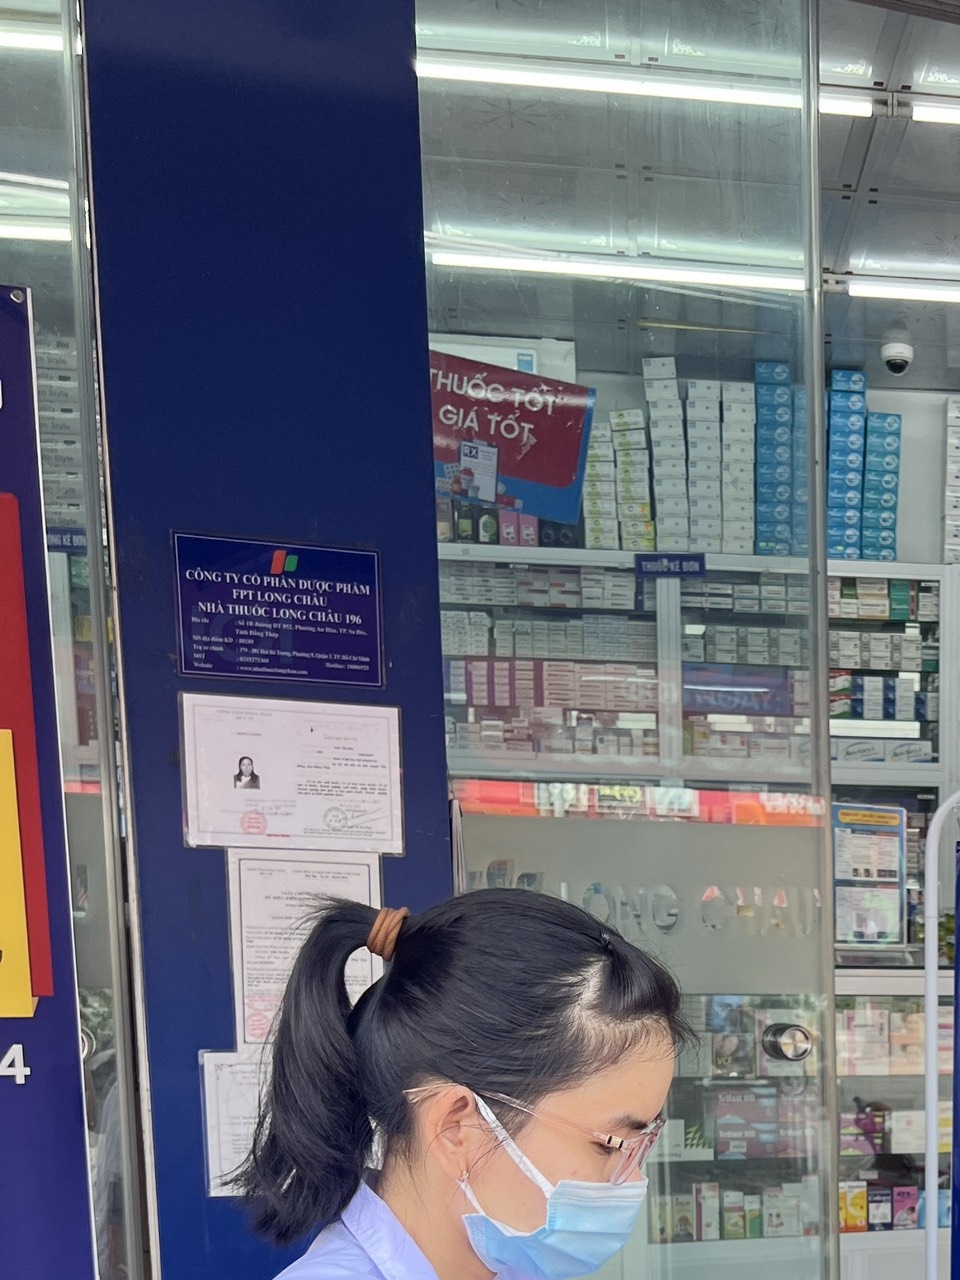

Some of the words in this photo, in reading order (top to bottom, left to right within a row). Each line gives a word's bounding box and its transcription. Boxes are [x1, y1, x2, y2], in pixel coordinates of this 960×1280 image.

[438, 404, 479, 432] GIÁ
[186, 567, 221, 583] CÔNG
[224, 573, 241, 584] TY
[299, 579, 333, 594] DƯỢC
[232, 589, 254, 601] FPT
[257, 591, 291, 604] LONG
[294, 593, 328, 607] CHÂU
[198, 600, 224, 614] NHÀ
[227, 603, 269, 617] THUỐC
[272, 607, 306, 621] LONG
[309, 609, 342, 624] CHÂU
[345, 614, 362, 625] 196
